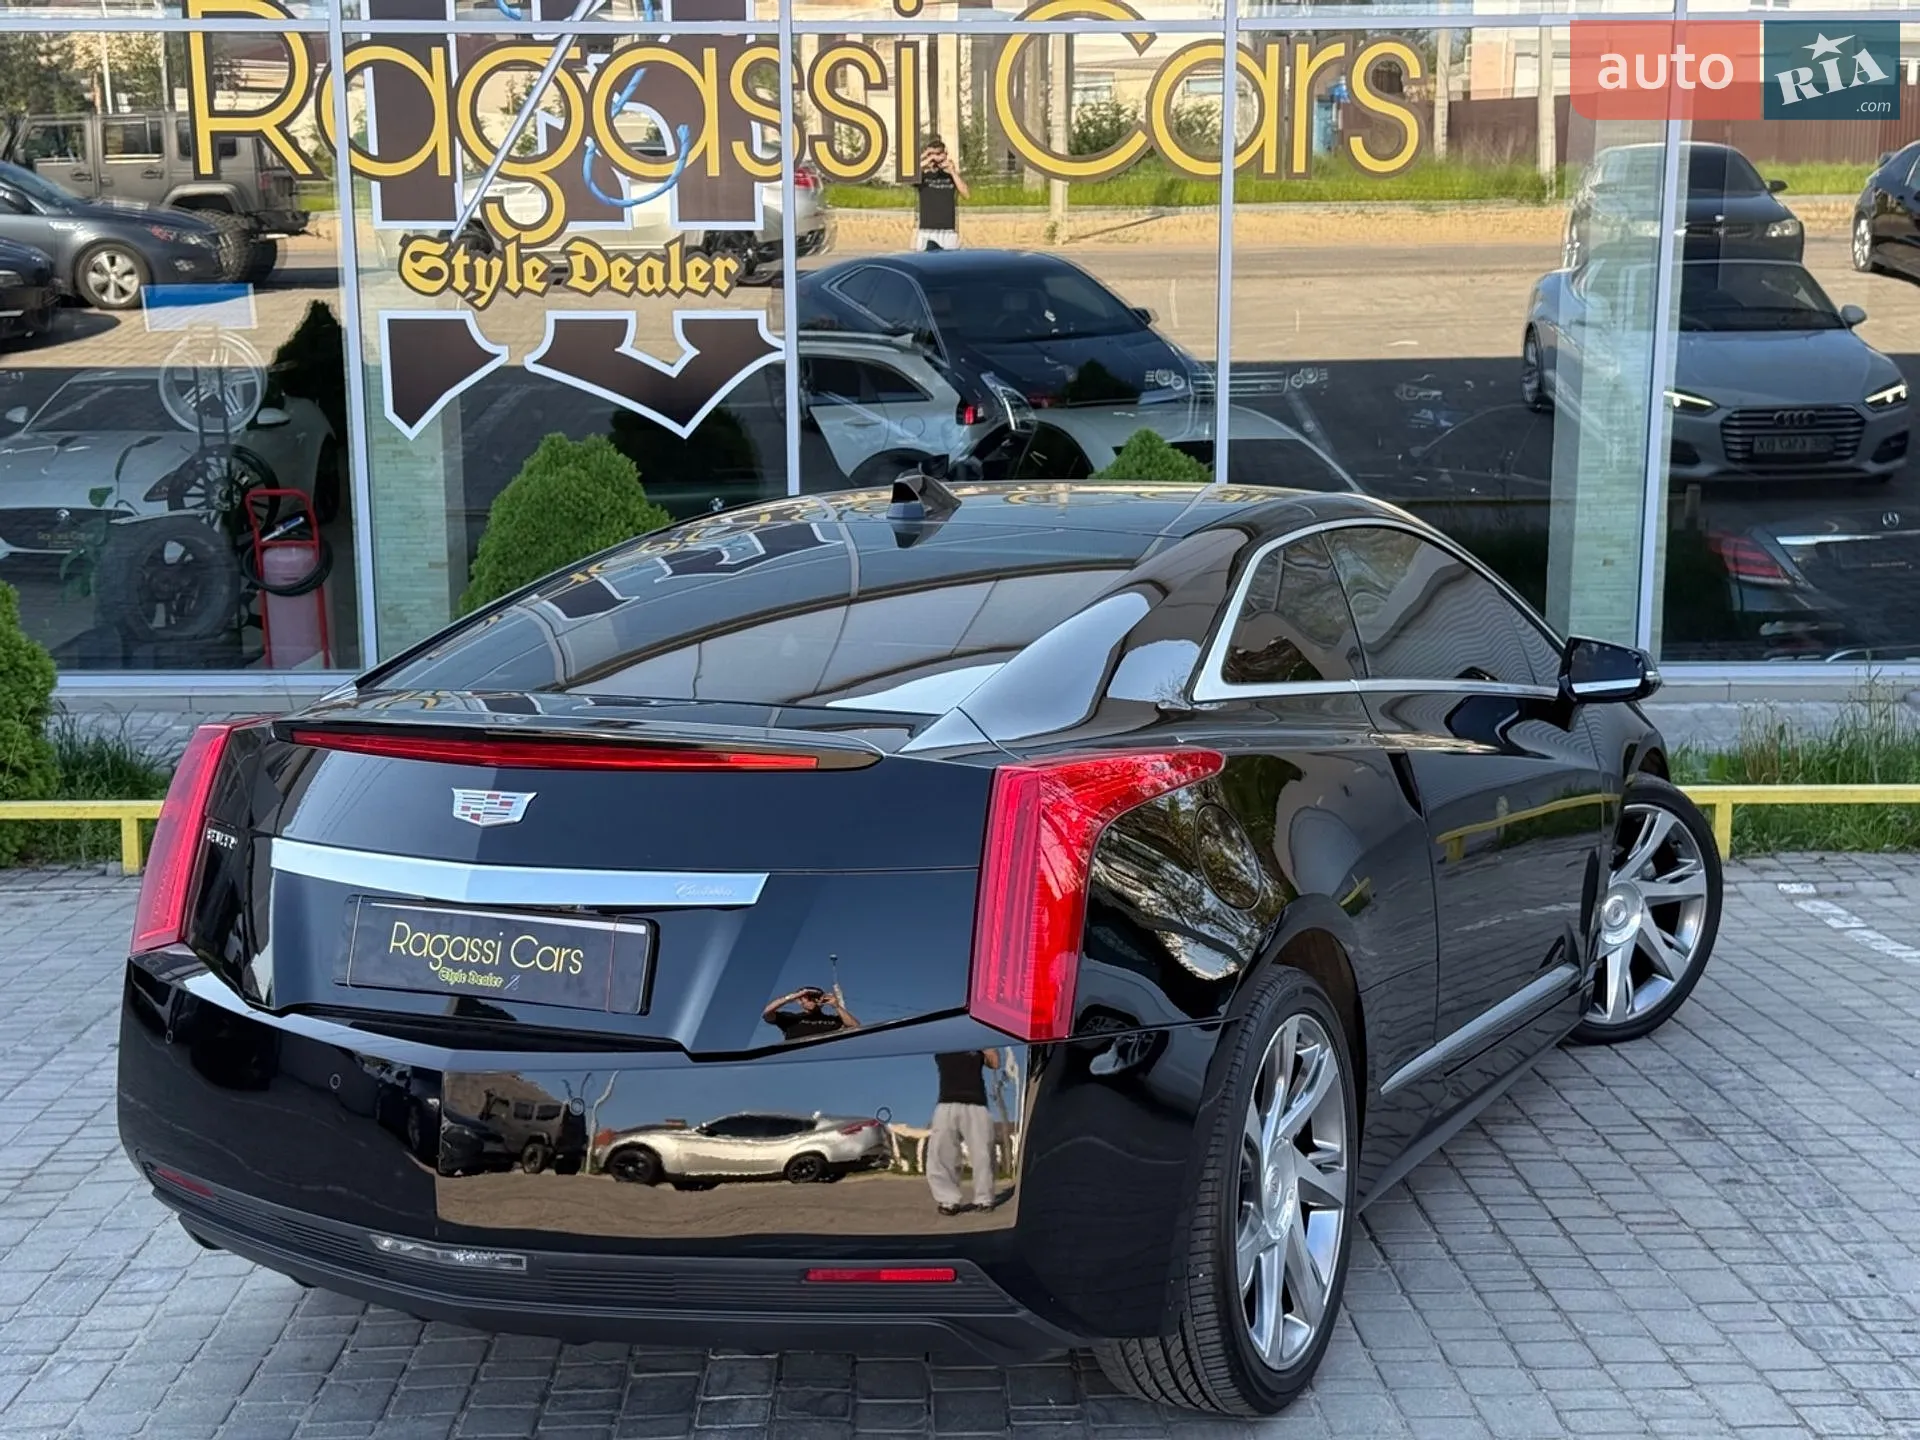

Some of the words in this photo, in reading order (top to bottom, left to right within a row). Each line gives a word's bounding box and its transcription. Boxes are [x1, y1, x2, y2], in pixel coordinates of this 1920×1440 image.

[186, 0, 920, 245] Ragassi
[992, 0, 1427, 182] Cars
[399, 232, 551, 310] Style
[561, 233, 742, 298] Dealer
[388, 921, 503, 972] Ragassi
[510, 934, 585, 975] Cars
